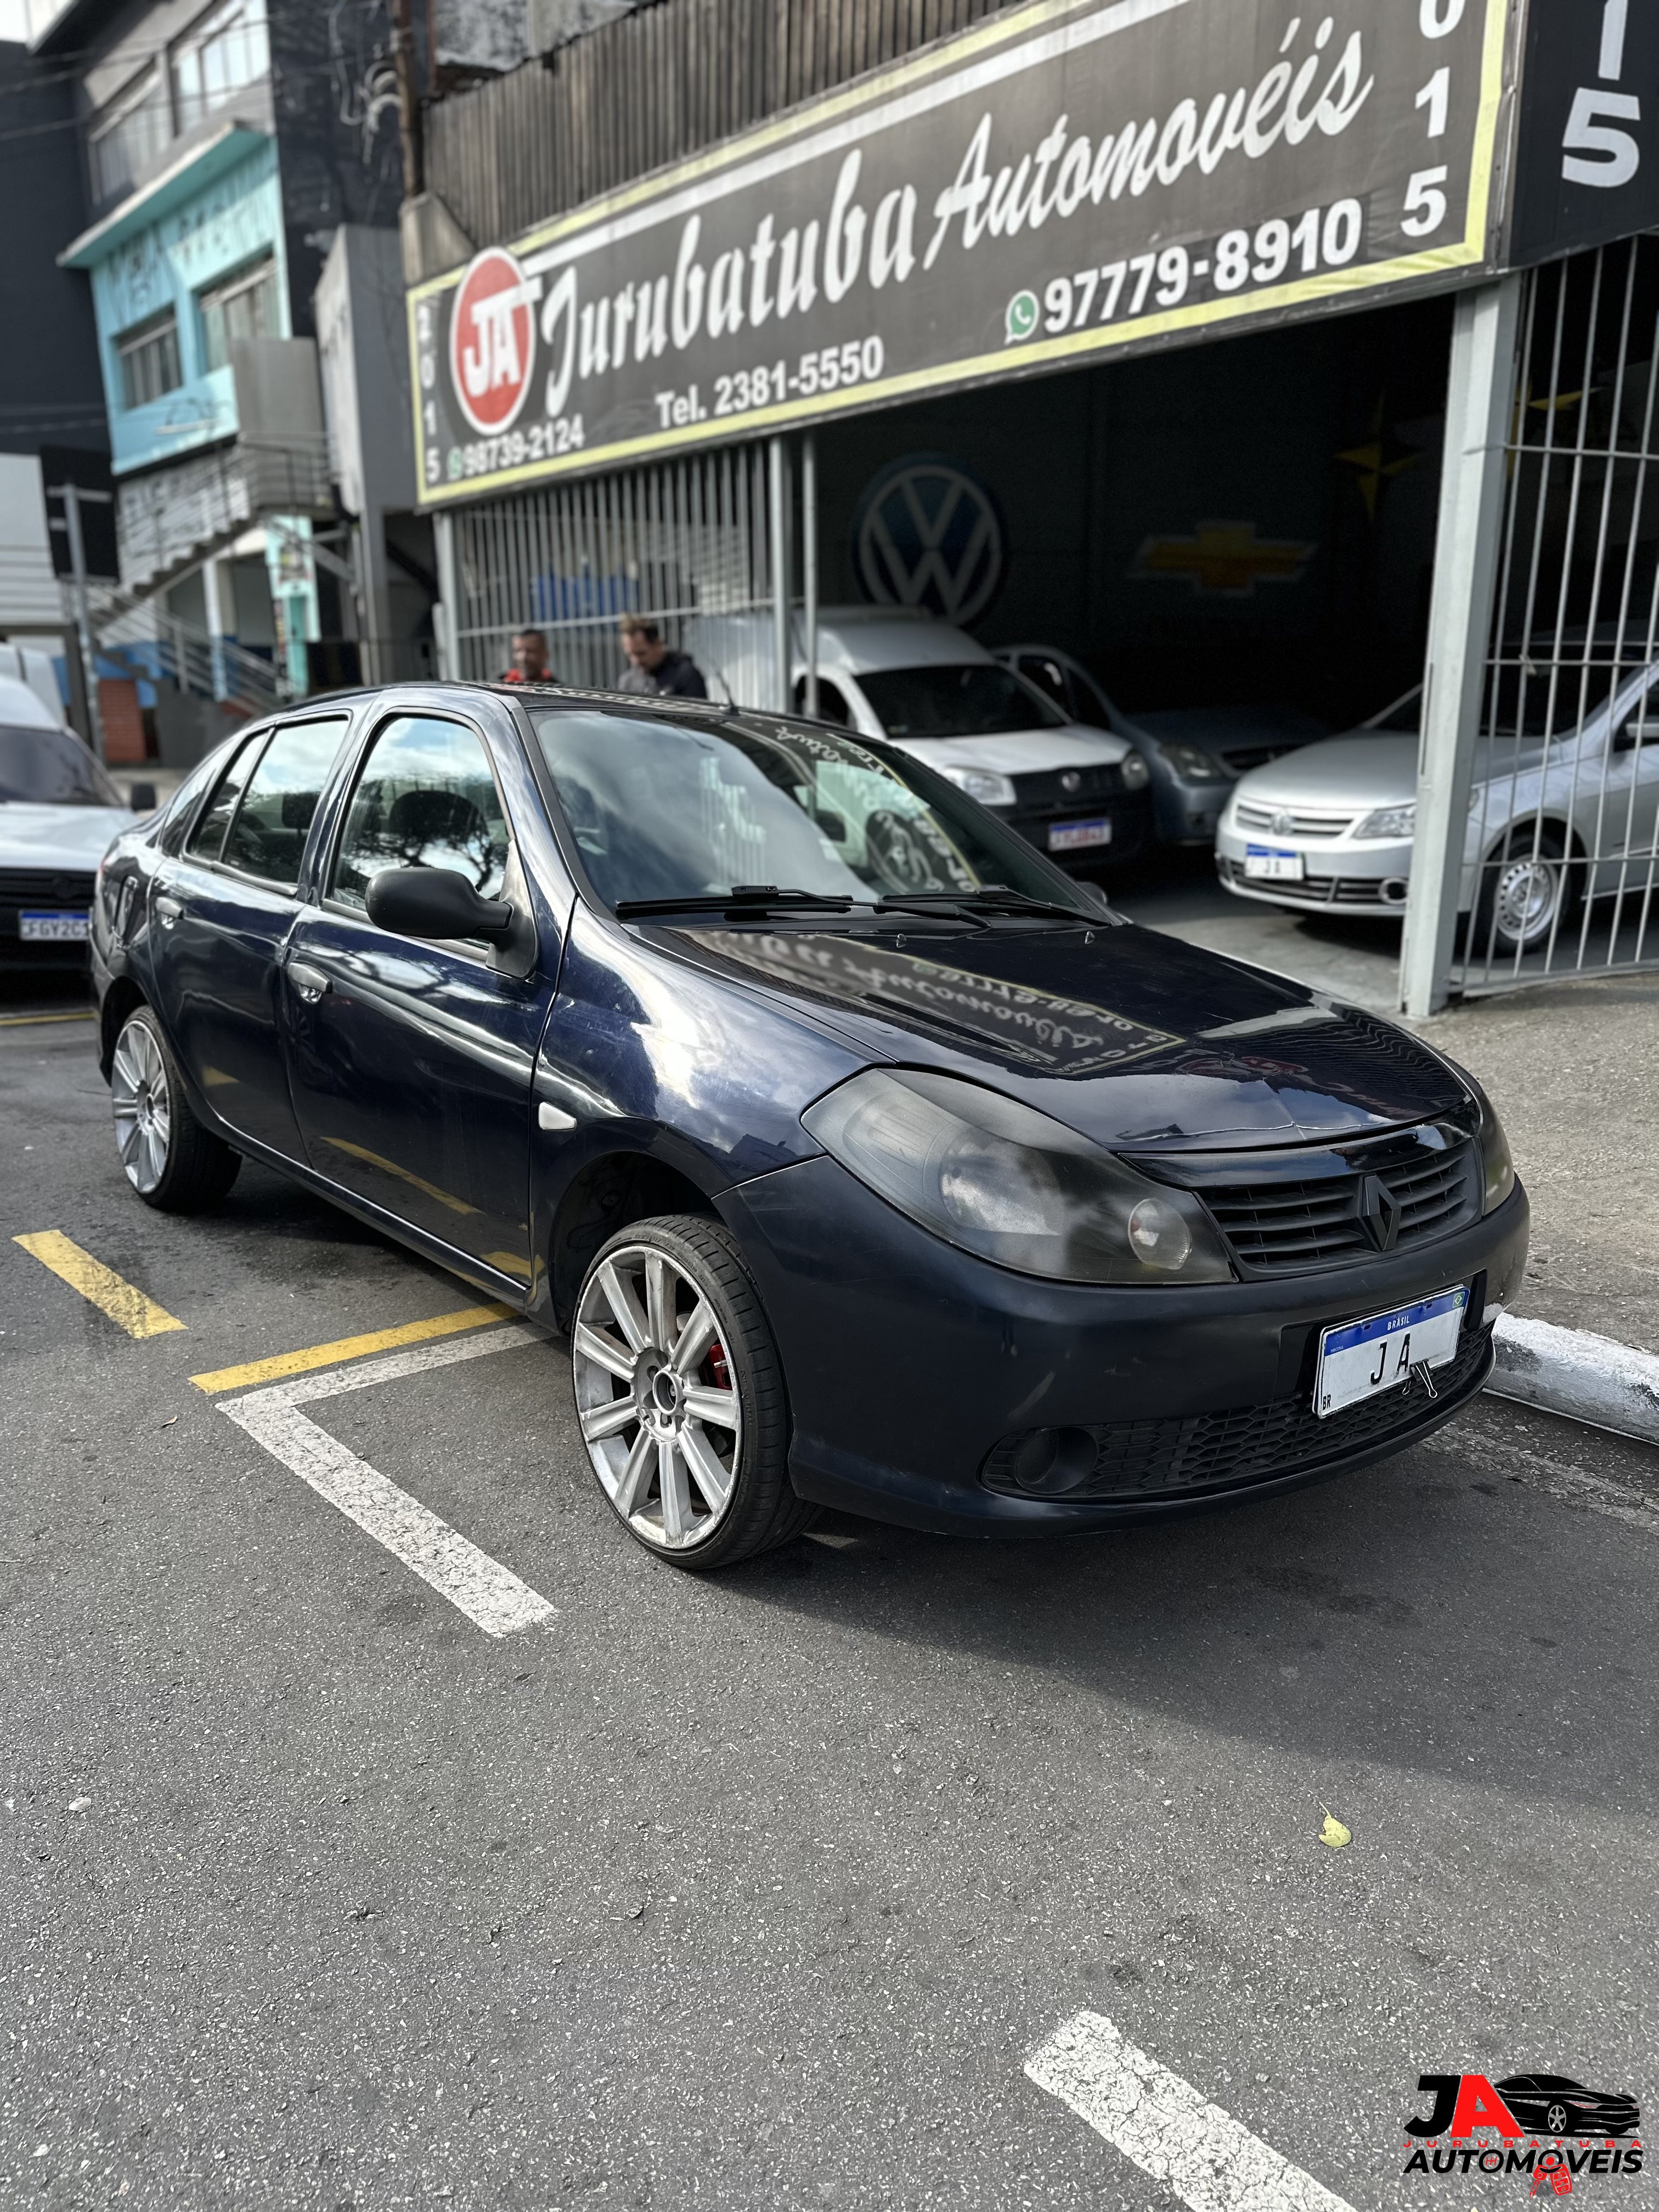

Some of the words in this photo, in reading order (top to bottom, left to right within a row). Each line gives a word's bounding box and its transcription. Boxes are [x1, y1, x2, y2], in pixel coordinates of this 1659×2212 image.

[541, 148, 917, 417] Jurubatuba
[923, 16, 1374, 270] Automovéis
[1044, 198, 1363, 332] 97779-8910
[462, 275, 543, 398] JA
[656, 391, 706, 428] Tel.
[714, 336, 884, 416] 2381-5550
[1387, 1316, 1410, 1330] BRASIL
[1323, 1394, 1331, 1411] BR
